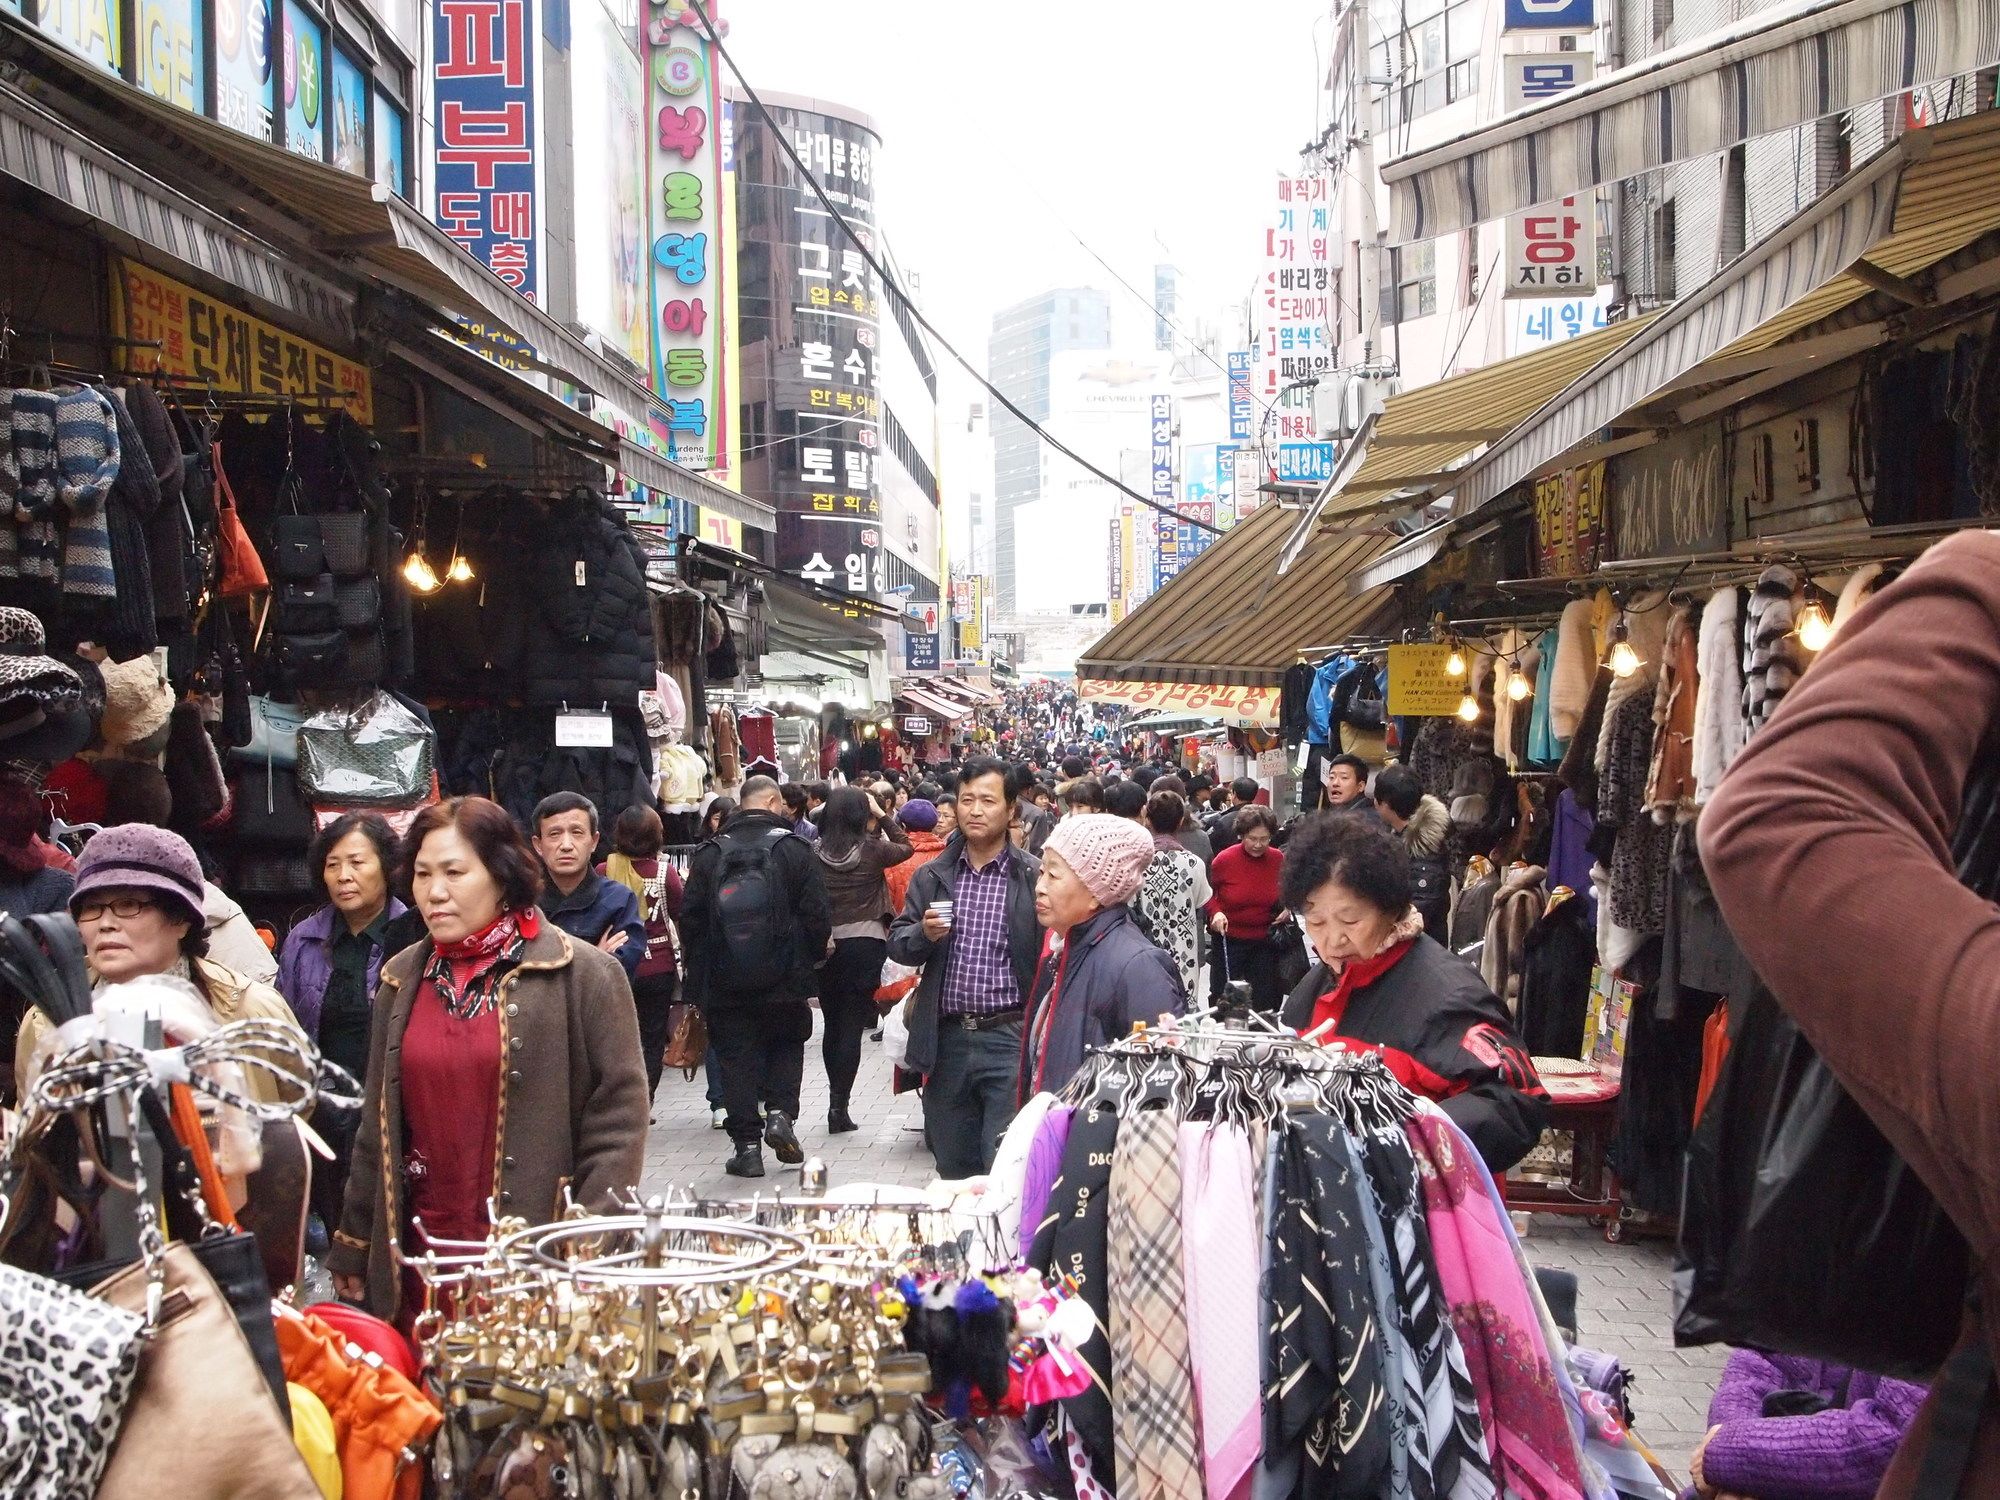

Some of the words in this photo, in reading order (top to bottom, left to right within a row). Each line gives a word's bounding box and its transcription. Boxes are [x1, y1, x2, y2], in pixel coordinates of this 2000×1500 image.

[436, 1, 532, 189] 피부
[1522, 64, 1575, 98] 몰
[794, 130, 846, 178] 남대문
[849, 141, 876, 185] 중앙
[1279, 179, 1326, 202] 매직기
[440, 193, 531, 239] 도매
[1279, 208, 1327, 231] 기계
[1524, 197, 1581, 264] 당
[1279, 238, 1327, 261] 가위
[1520, 267, 1583, 284] 지하
[1152, 396, 1171, 492] 삼성까운
[1075, 1187, 1089, 1218] D&G
[1071, 1253, 1086, 1285] D&G
